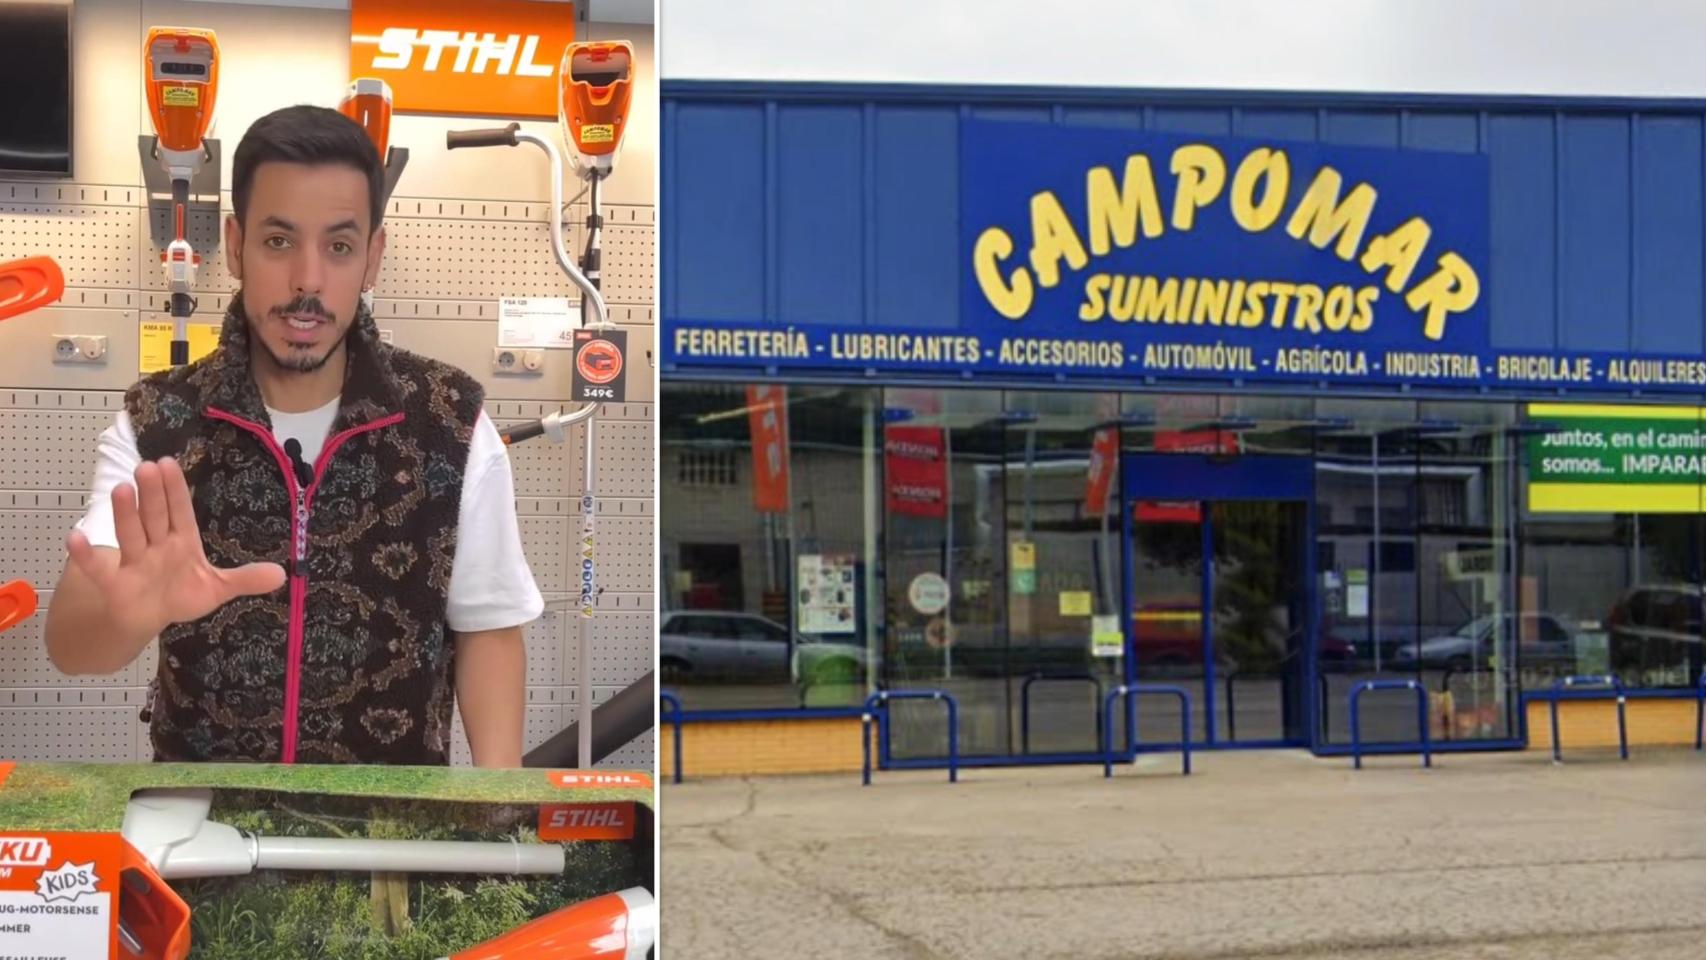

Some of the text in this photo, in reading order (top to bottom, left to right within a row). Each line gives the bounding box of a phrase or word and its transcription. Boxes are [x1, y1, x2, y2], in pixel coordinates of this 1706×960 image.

[371, 27, 554, 77] STIHL
[973, 144, 1480, 340] CAMPOMAR
[1079, 274, 1380, 334] SUMINISTROS
[675, 326, 809, 359] FERRETERÍA
[831, 333, 980, 363] LUBRICANTES
[999, 338, 1124, 368] ACCESORIOS
[1144, 341, 1256, 371] AUTOMÓVIL
[1275, 345, 1368, 375] AGRÍCOLA
[1385, 352, 1481, 378] INDUSTRIA
[1498, 355, 1592, 381] BRICOLAJE
[1608, 359, 1706, 385] ALQUILERES
[583, 388, 614, 398] 349€
[1542, 428, 1608, 449] Juntos,
[1611, 432, 1633, 448] en
[1637, 428, 1654, 448] el
[1542, 457, 1615, 473] somos...
[562, 775, 640, 783] STIHL
[549, 809, 624, 827] STIHL
[45, 870, 89, 894] KIDS
[0, 904, 99, 915] UG-MOTORSENSE
